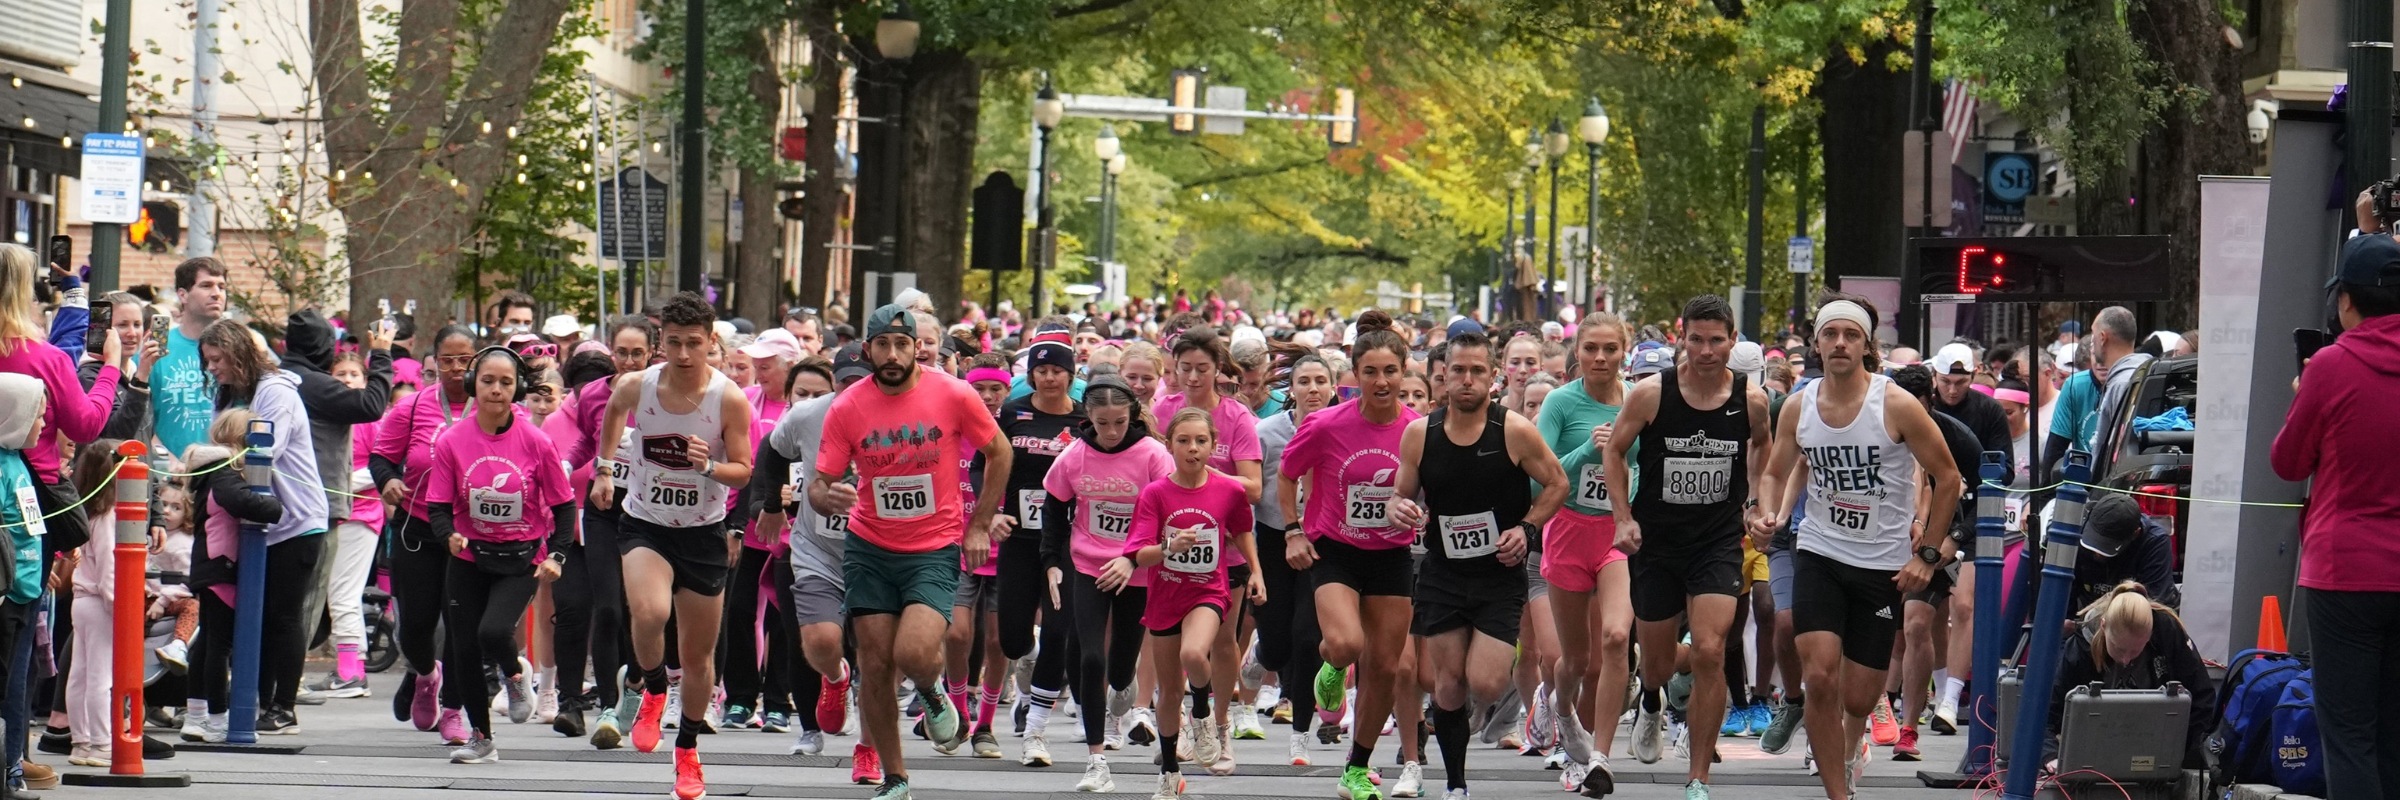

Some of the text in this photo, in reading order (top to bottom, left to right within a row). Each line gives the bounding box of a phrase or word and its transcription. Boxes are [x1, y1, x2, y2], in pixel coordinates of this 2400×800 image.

[85, 138, 101, 148] PAY
[115, 140, 138, 149] PARK
[1664, 436, 1691, 447] WEST
[1703, 439, 1739, 452] CHESTER
[864, 453, 895, 468] TRAIL
[916, 458, 940, 469] RUN
[1342, 454, 1356, 469] UNITE
[1355, 449, 1369, 458] FOR
[1382, 449, 1391, 458] 5K
[1803, 445, 1881, 468] TURTLE
[612, 463, 630, 480] 37
[1812, 466, 1885, 492] CREEK
[1077, 475, 1134, 493] Barbie
[1584, 480, 1607, 500] 26
[1670, 470, 1724, 495] 8800
[650, 486, 699, 506] 2068
[880, 491, 927, 510] 1260
[480, 503, 512, 517] 602
[1351, 501, 1386, 520] 233
[1828, 506, 1869, 530] 1257
[1097, 514, 1132, 533] 1272
[1340, 528, 1370, 540] markets
[1449, 528, 1490, 550] 1237
[2278, 746, 2308, 760] SHS
